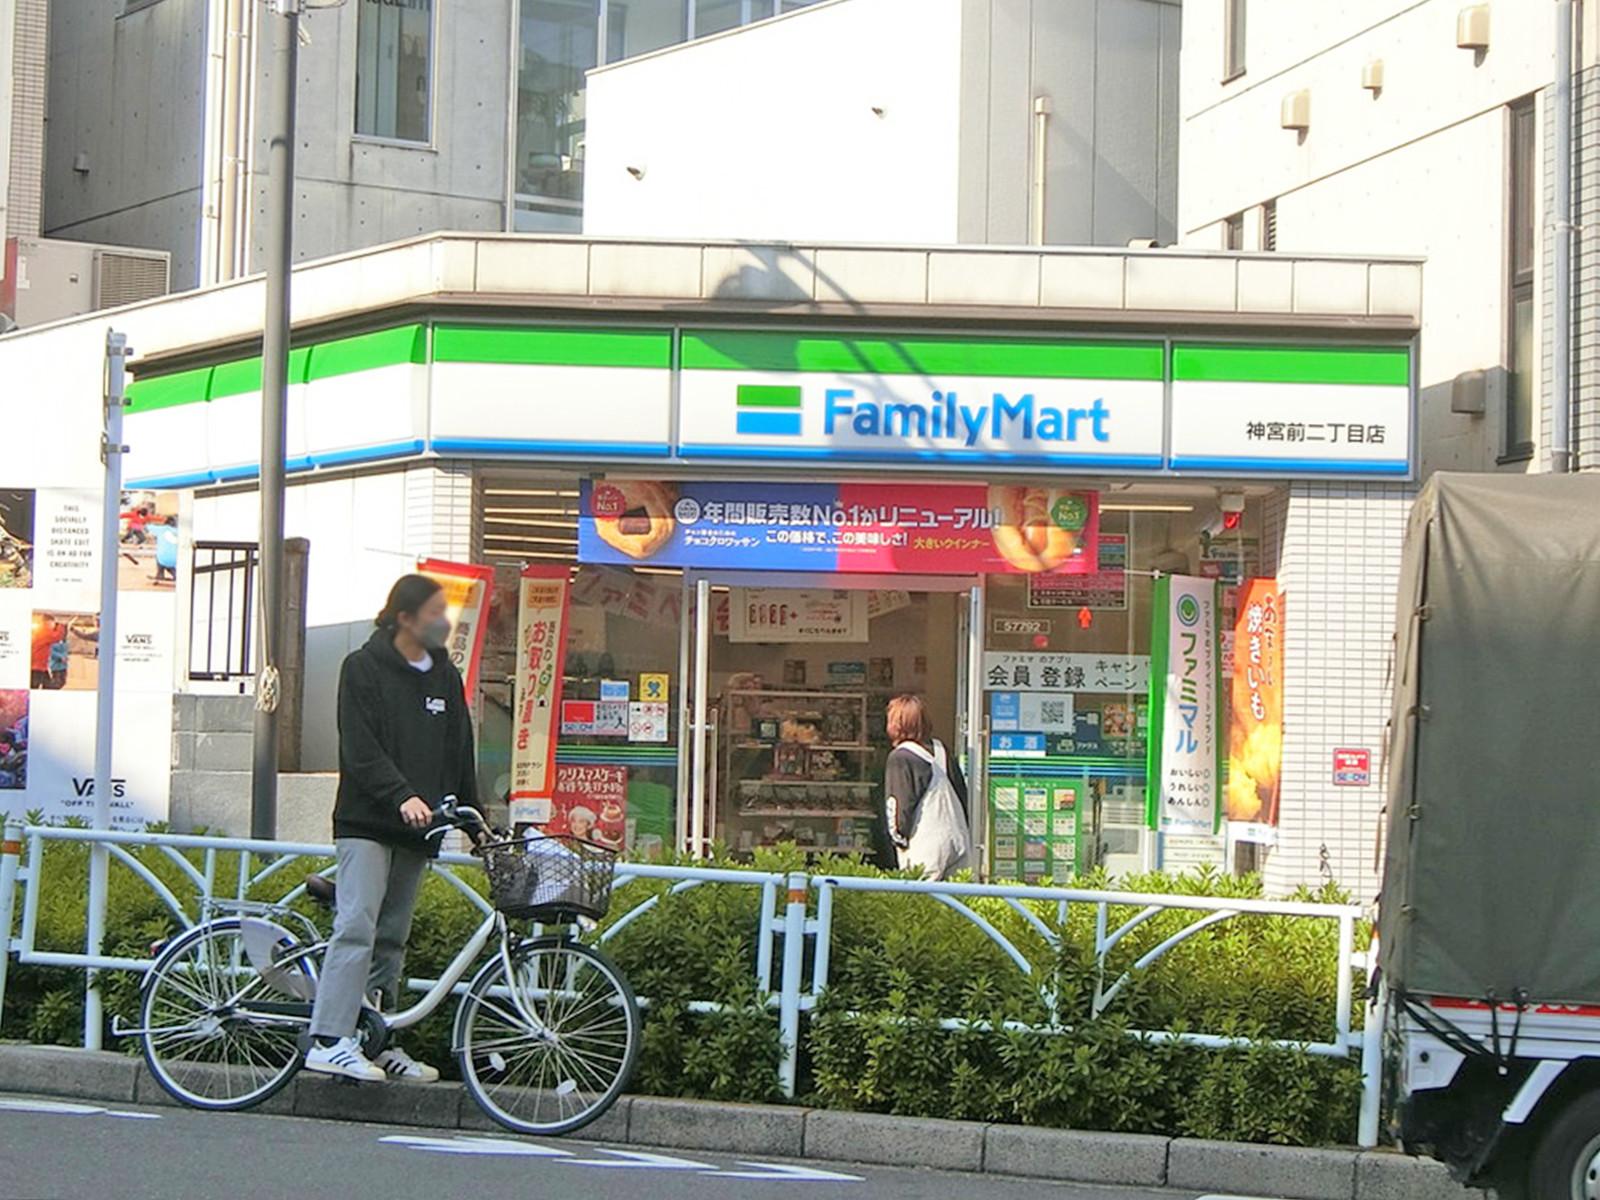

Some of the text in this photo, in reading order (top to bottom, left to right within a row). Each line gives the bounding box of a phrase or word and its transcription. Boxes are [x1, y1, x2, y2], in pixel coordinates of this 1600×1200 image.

[824, 389, 1109, 446] FamilyMart
[1246, 421, 1386, 444] 神宮前二丁目店
[1176, 632, 1199, 754] ファミマル
[558, 767, 624, 783] クリスマスケーキ
